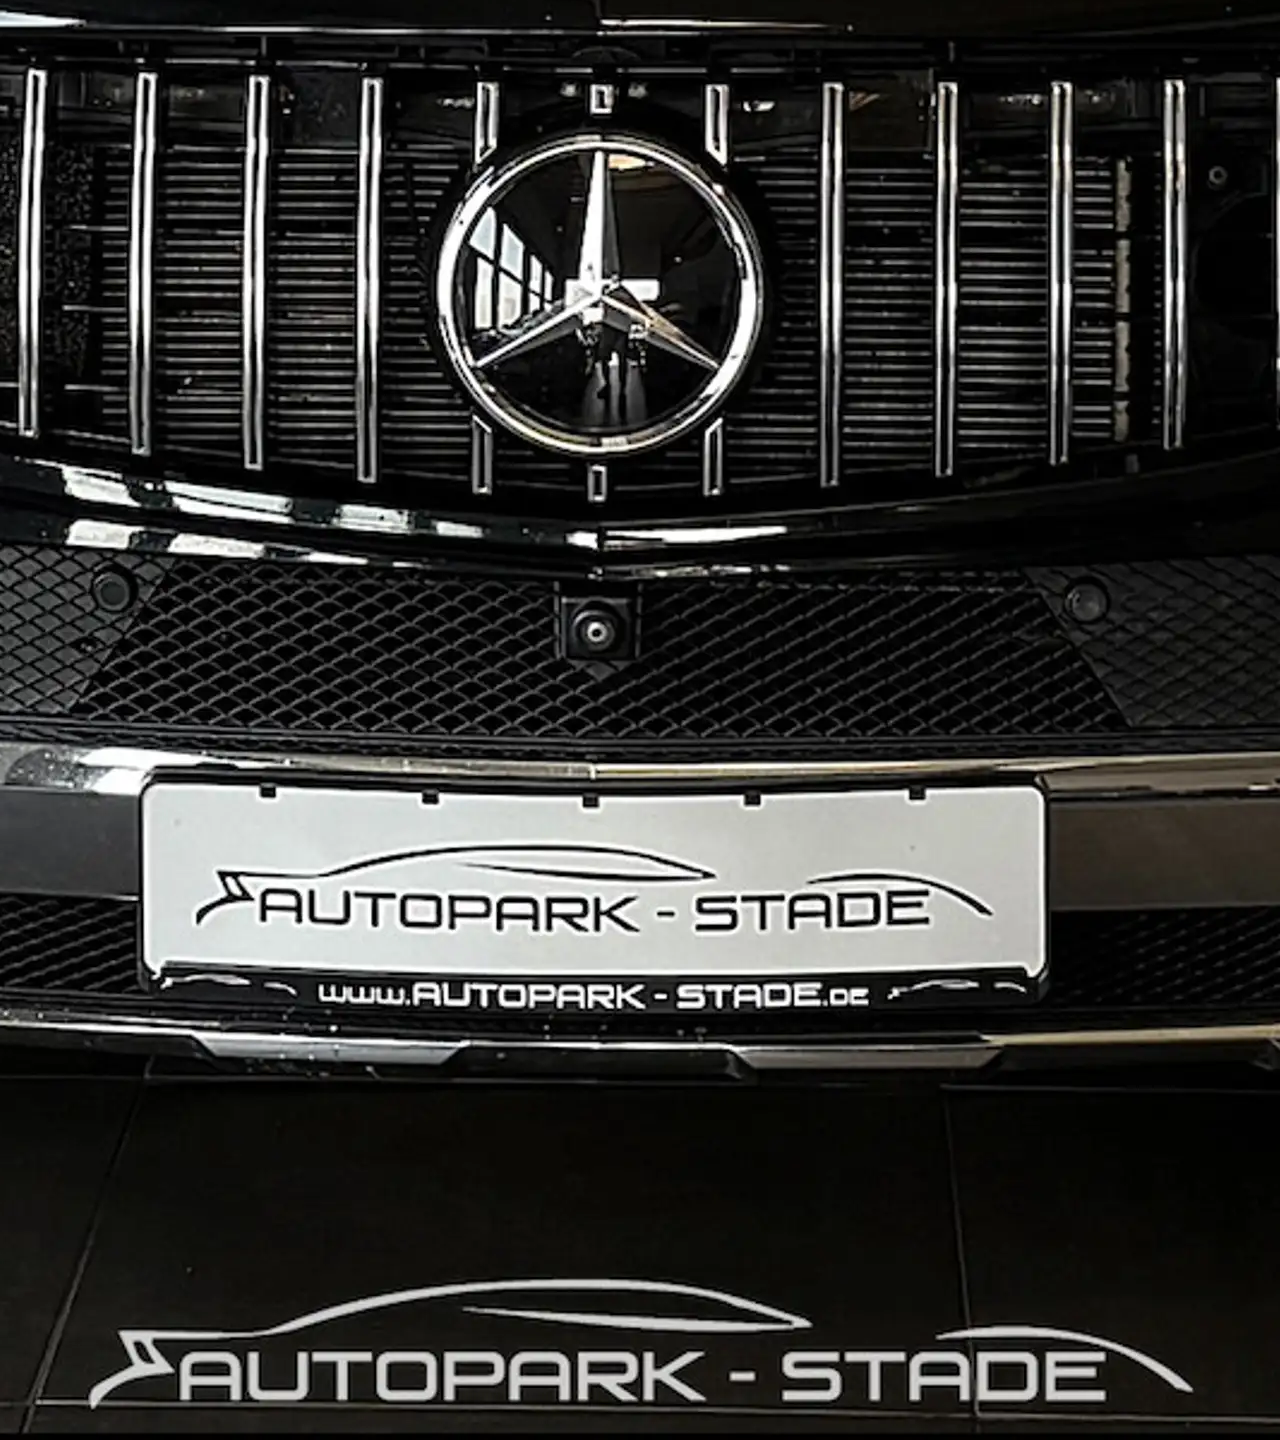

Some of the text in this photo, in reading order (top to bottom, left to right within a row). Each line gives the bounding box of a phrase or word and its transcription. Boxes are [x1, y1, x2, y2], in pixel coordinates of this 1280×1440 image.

[259, 887, 641, 934] AUTOPARK
[694, 888, 931, 932] STADE
[317, 981, 647, 1010] www.AUTOPARK
